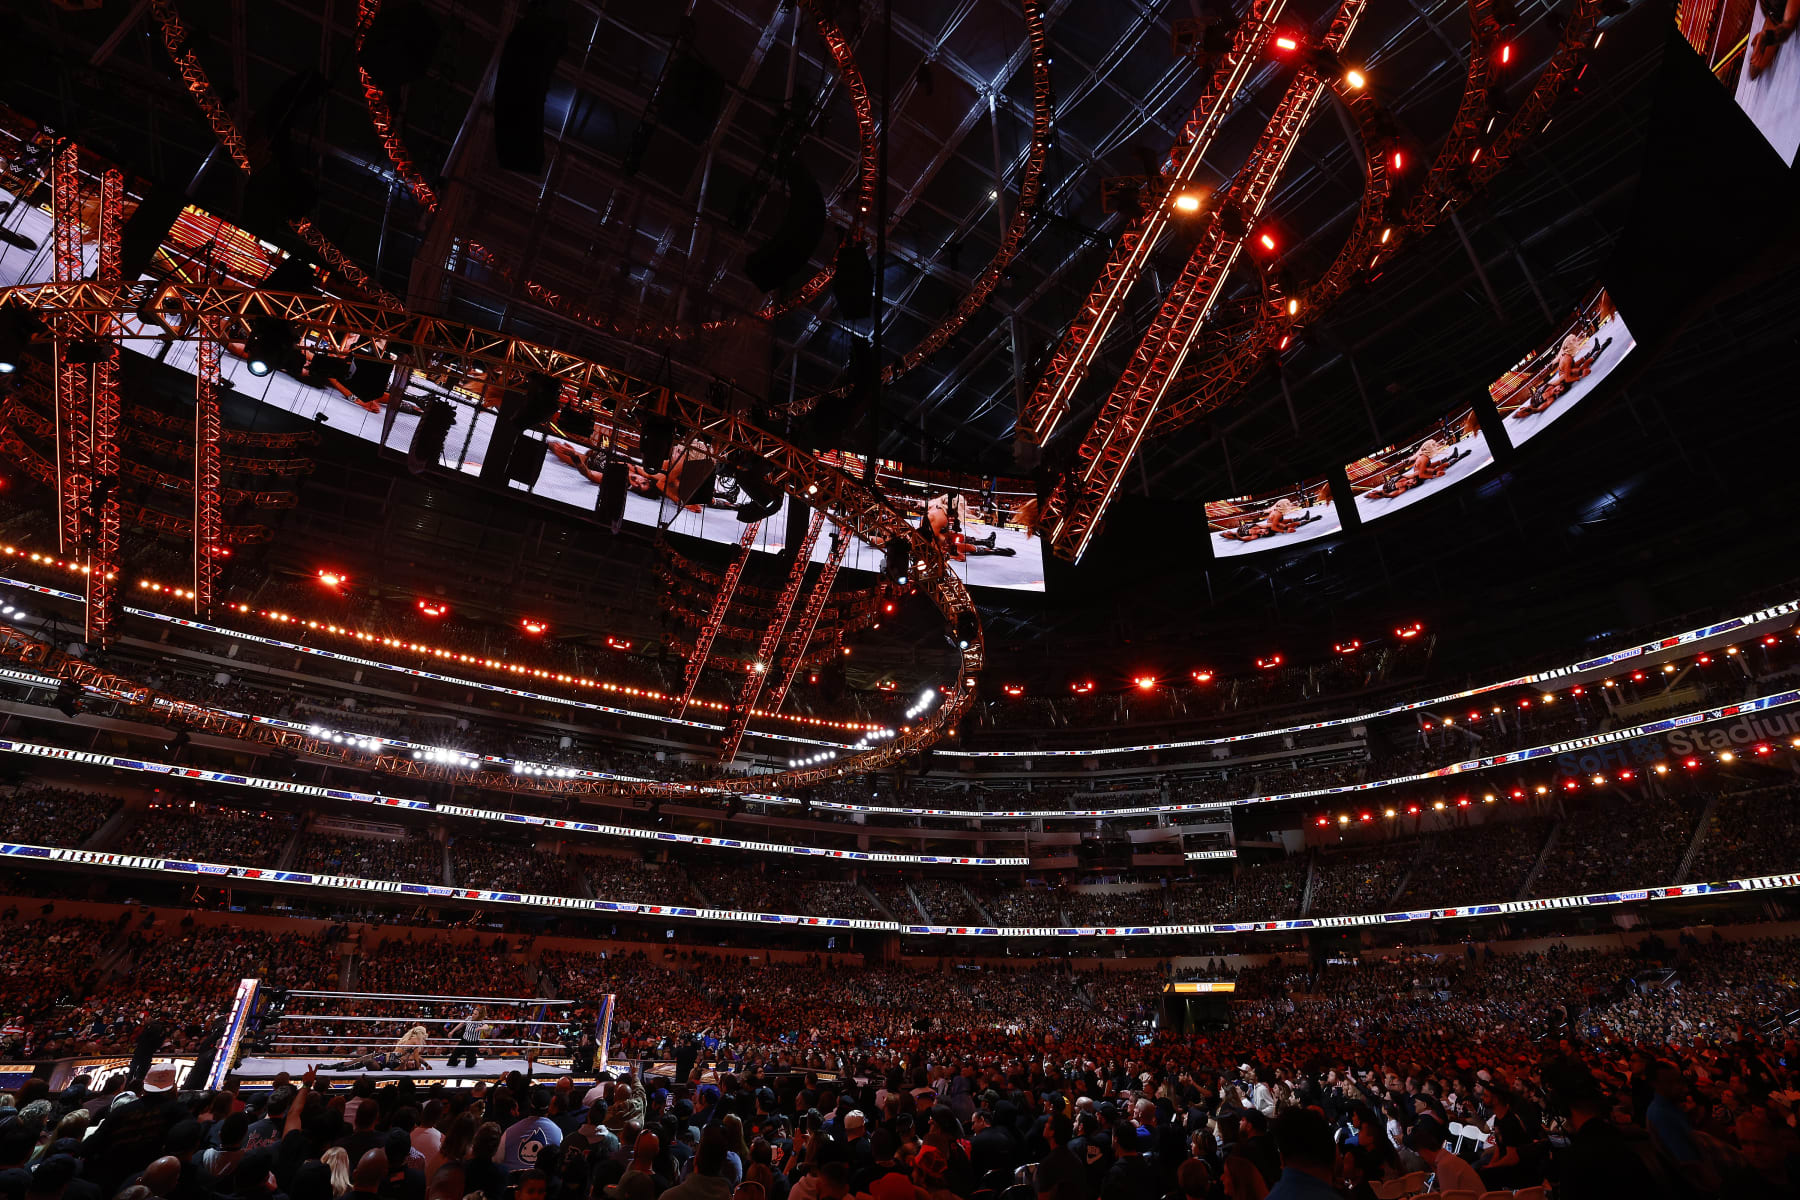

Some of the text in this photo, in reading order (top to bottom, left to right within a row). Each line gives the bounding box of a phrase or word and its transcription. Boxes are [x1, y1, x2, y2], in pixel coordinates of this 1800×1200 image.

[1740, 601, 1799, 625] WREST
[1613, 648, 1642, 662] SNICKERS
[1676, 715, 1703, 726] SNICKERS
[1549, 727, 1645, 753] WRESTLEMANIA
[11, 743, 114, 766] WRESTLEMANIA
[1557, 743, 1628, 776] SoFi
[246, 778, 328, 796] WRESTLEMANIA
[49, 848, 165, 870] WRESTLEMANIA
[311, 875, 402, 893] WRESTLEMANIA
[520, 894, 596, 909] WRESTLEMANIA
[1499, 896, 1590, 913] WRESTLEMANIA
[1312, 914, 1387, 927] WRESTLEMANIA
